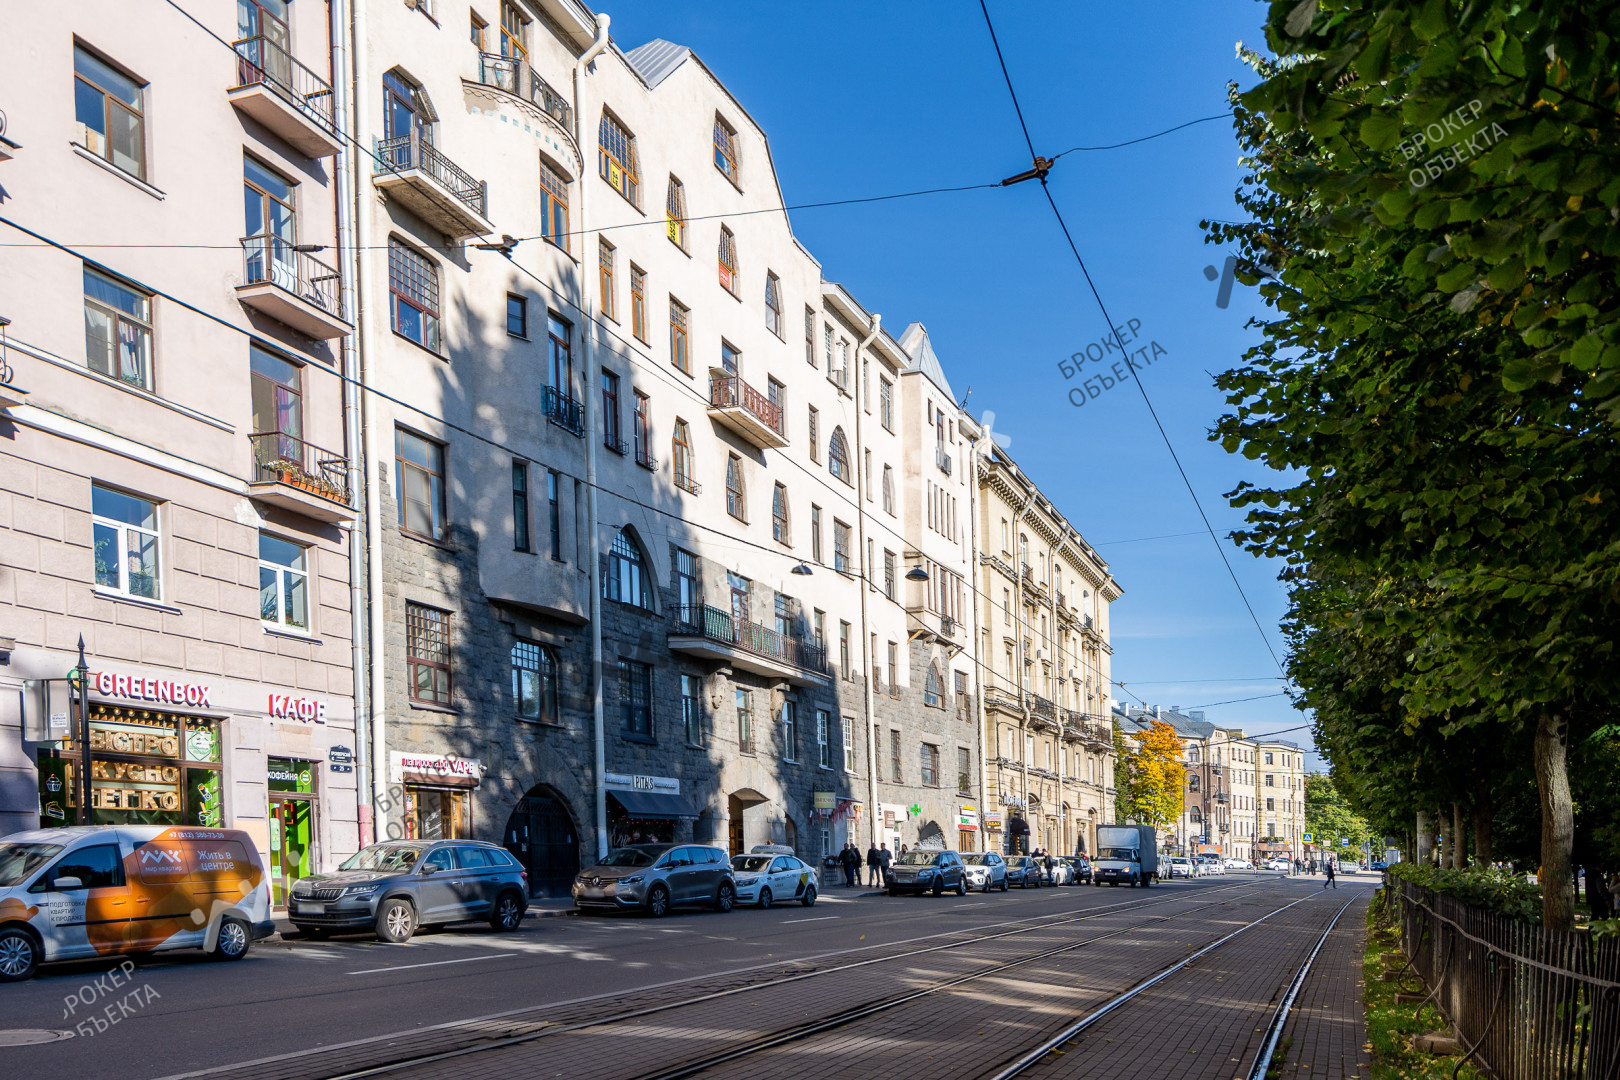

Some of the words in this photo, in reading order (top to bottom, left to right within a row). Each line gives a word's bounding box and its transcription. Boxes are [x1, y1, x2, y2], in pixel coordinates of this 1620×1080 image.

[96, 671, 212, 708] GREENBOX
[268, 693, 328, 724] КАФЕ
[80, 760, 179, 783] КУСНО
[197, 850, 224, 860] Жить
[201, 862, 235, 872] центре
